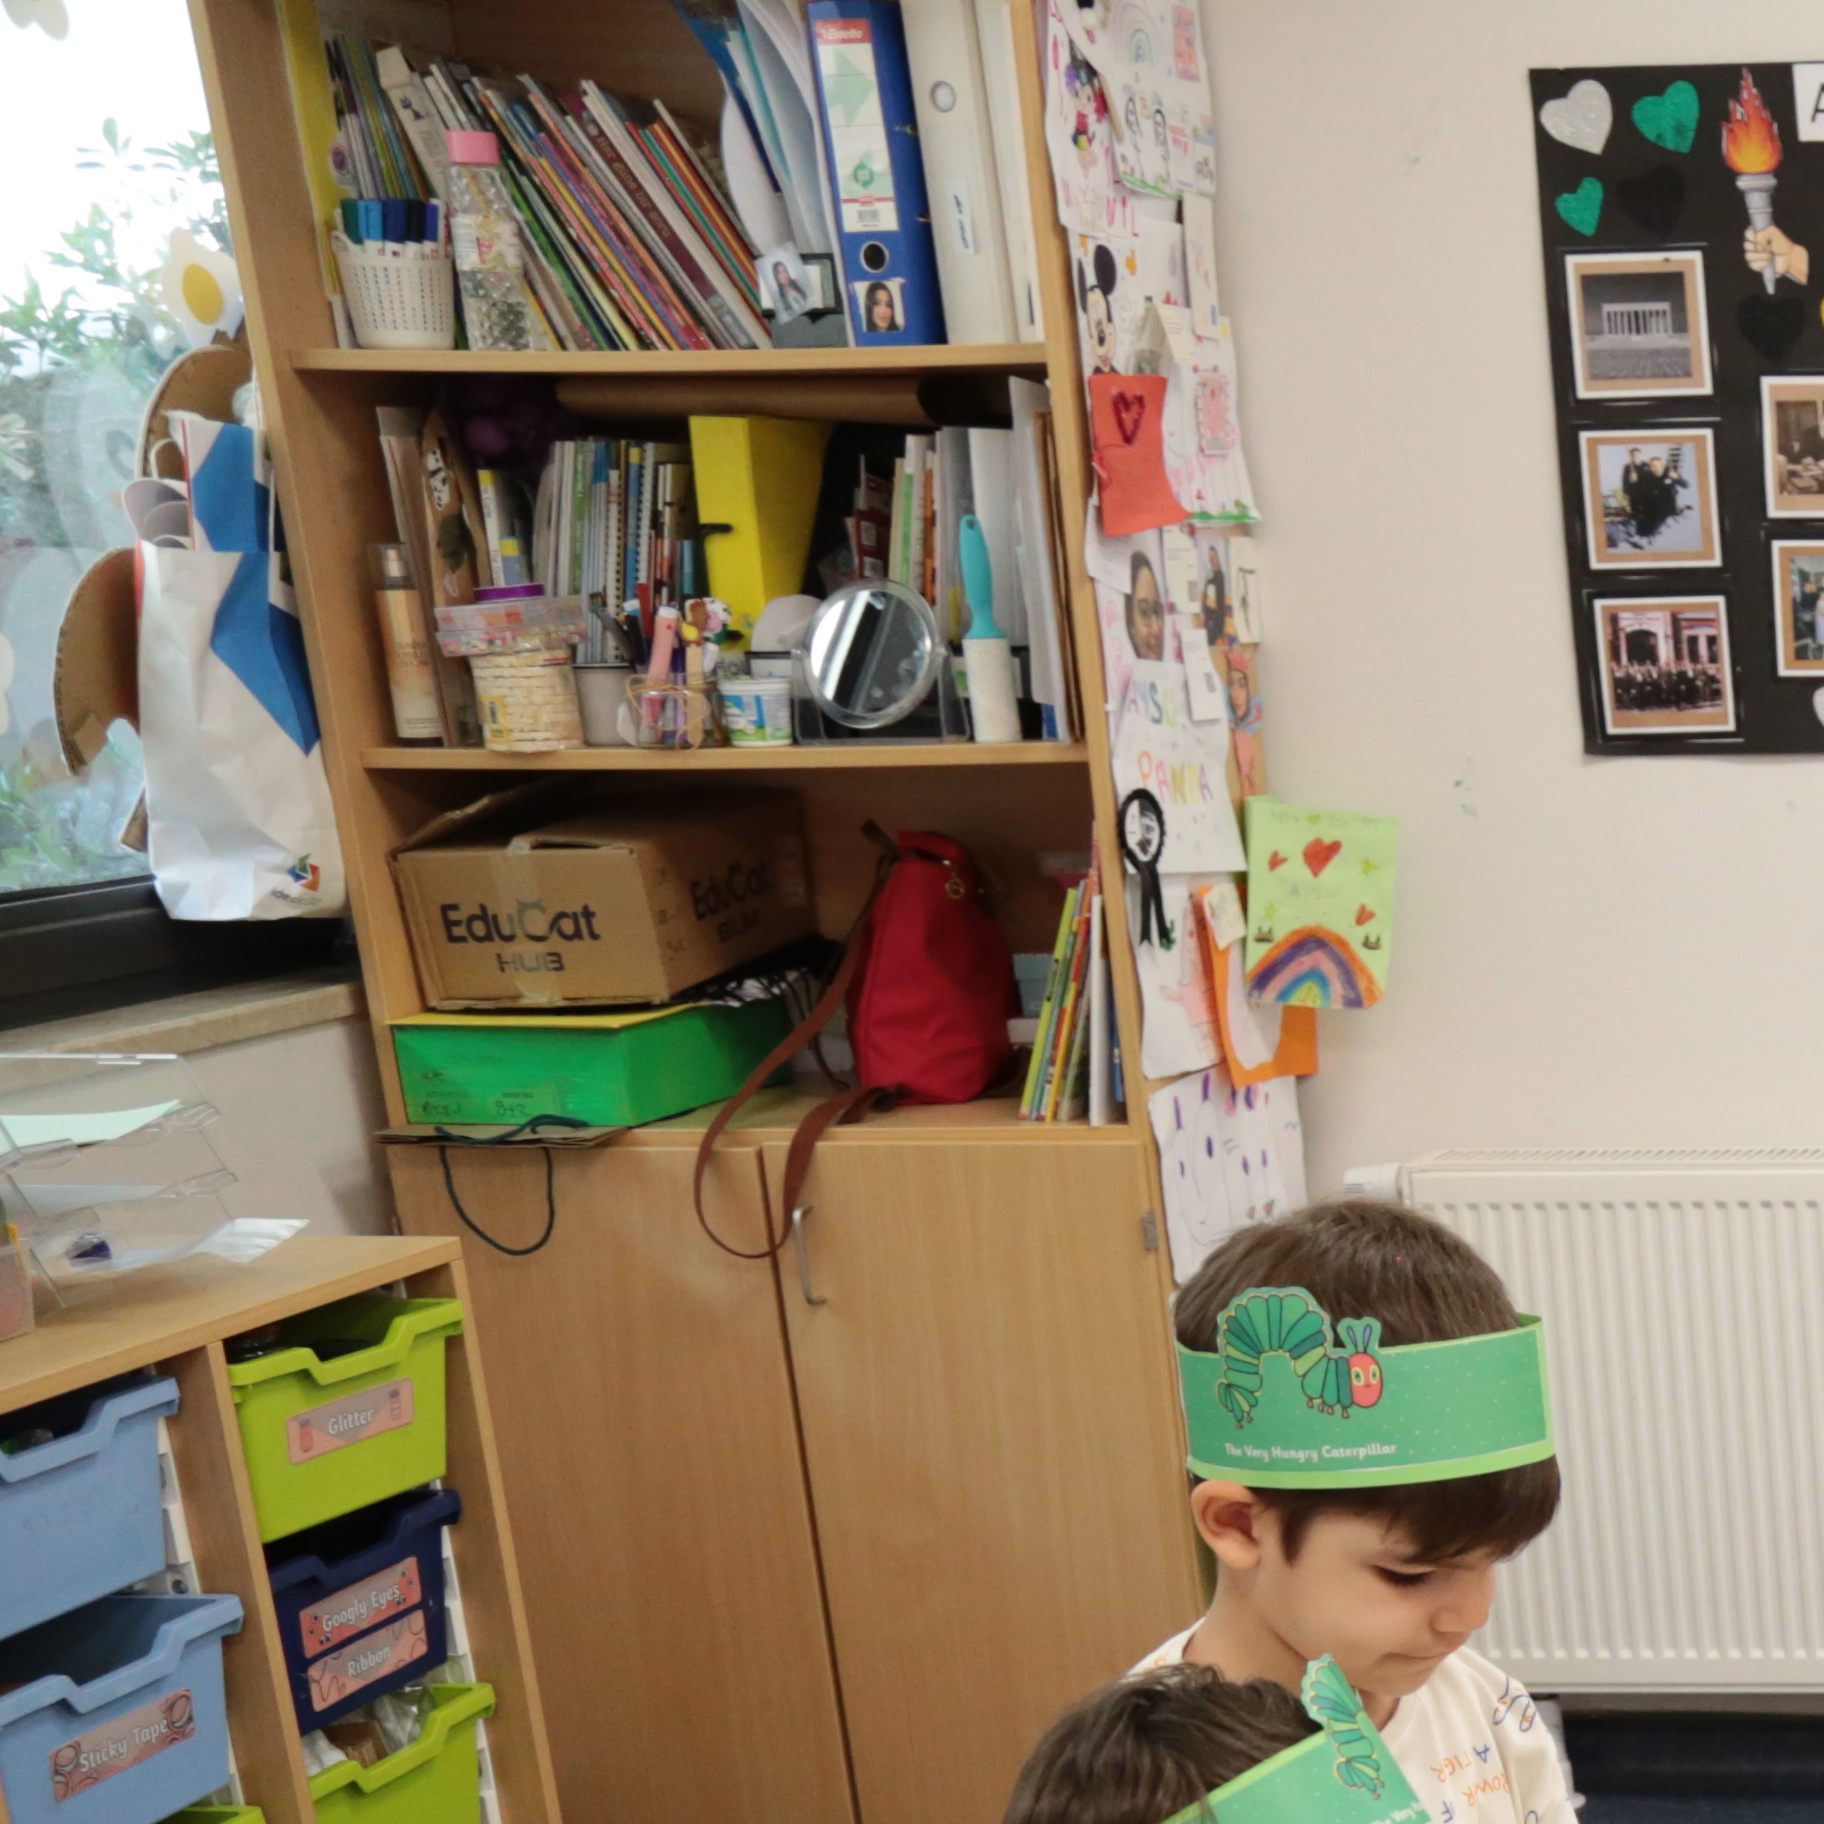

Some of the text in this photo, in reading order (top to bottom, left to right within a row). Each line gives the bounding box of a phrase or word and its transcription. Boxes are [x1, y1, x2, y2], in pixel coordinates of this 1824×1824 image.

[441, 902, 601, 944] EduCat
[496, 952, 566, 973] HUB
[328, 1408, 375, 1436] Glitter
[1225, 1442, 1397, 1463] The Very Hungry Caterpillar
[321, 1584, 401, 1632] Googly Eyes
[347, 1645, 391, 1678] Ribbon
[79, 1718, 168, 1774] Sticky Tape
